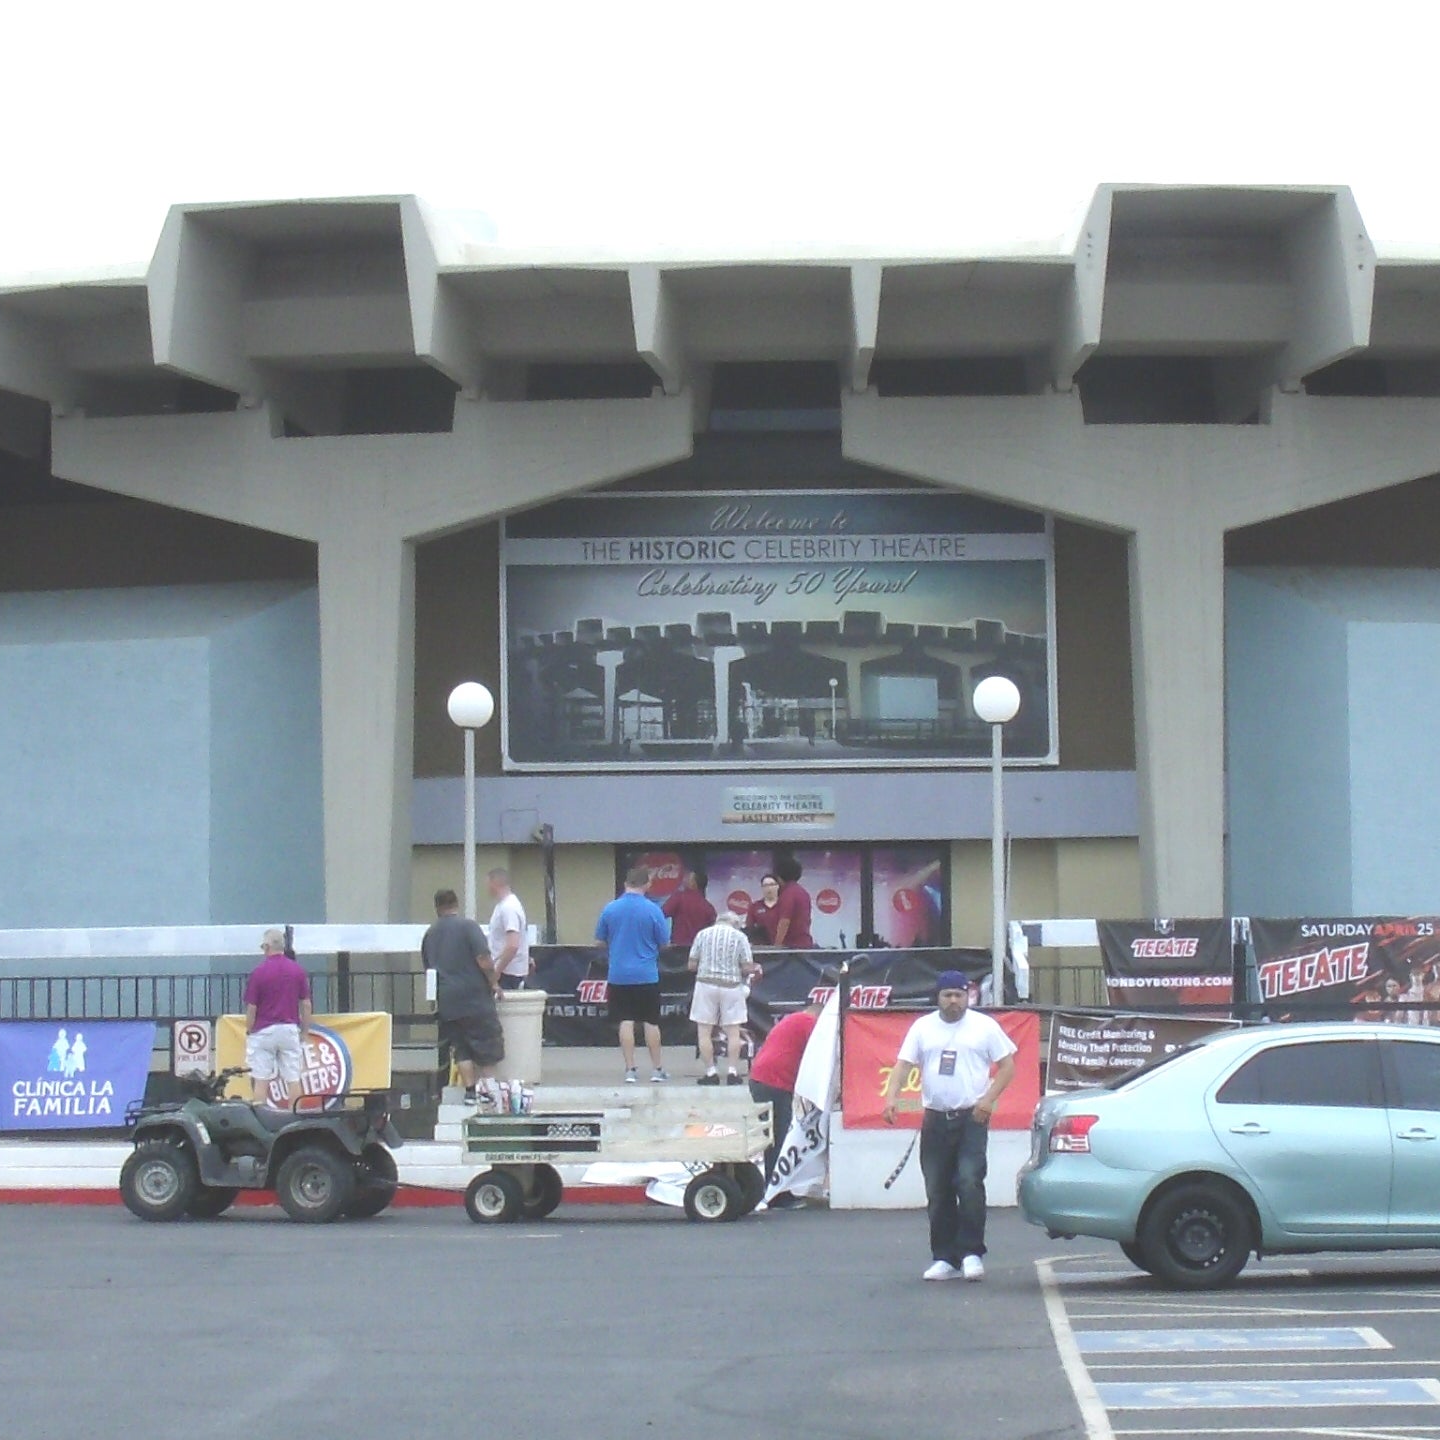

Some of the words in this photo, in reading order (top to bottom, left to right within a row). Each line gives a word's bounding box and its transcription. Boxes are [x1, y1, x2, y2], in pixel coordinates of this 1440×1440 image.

[709, 503, 820, 532] Welcome
[830, 509, 849, 529] to
[581, 540, 621, 561] THE
[628, 539, 736, 561] HISTORIC
[744, 538, 861, 560] CELEBRITY
[870, 536, 966, 558] THEATRE
[636, 567, 778, 606] Celebrating
[785, 570, 826, 595] 50
[831, 565, 919, 605] Years!
[733, 801, 781, 811] CELEBRITY
[783, 801, 823, 810] THEATRE
[1301, 923, 1374, 938] SATURDAY
[1417, 922, 1434, 937] 25
[1130, 937, 1199, 958] TECATE
[1259, 942, 1370, 1000] TECATE
[546, 1005, 597, 1017] TASTE
[12, 1077, 86, 1096] CLÍNICA
[90, 1080, 114, 1095] LA
[269, 1064, 339, 1102] BUTER'S
[13, 1097, 112, 1117] FAMILIA
